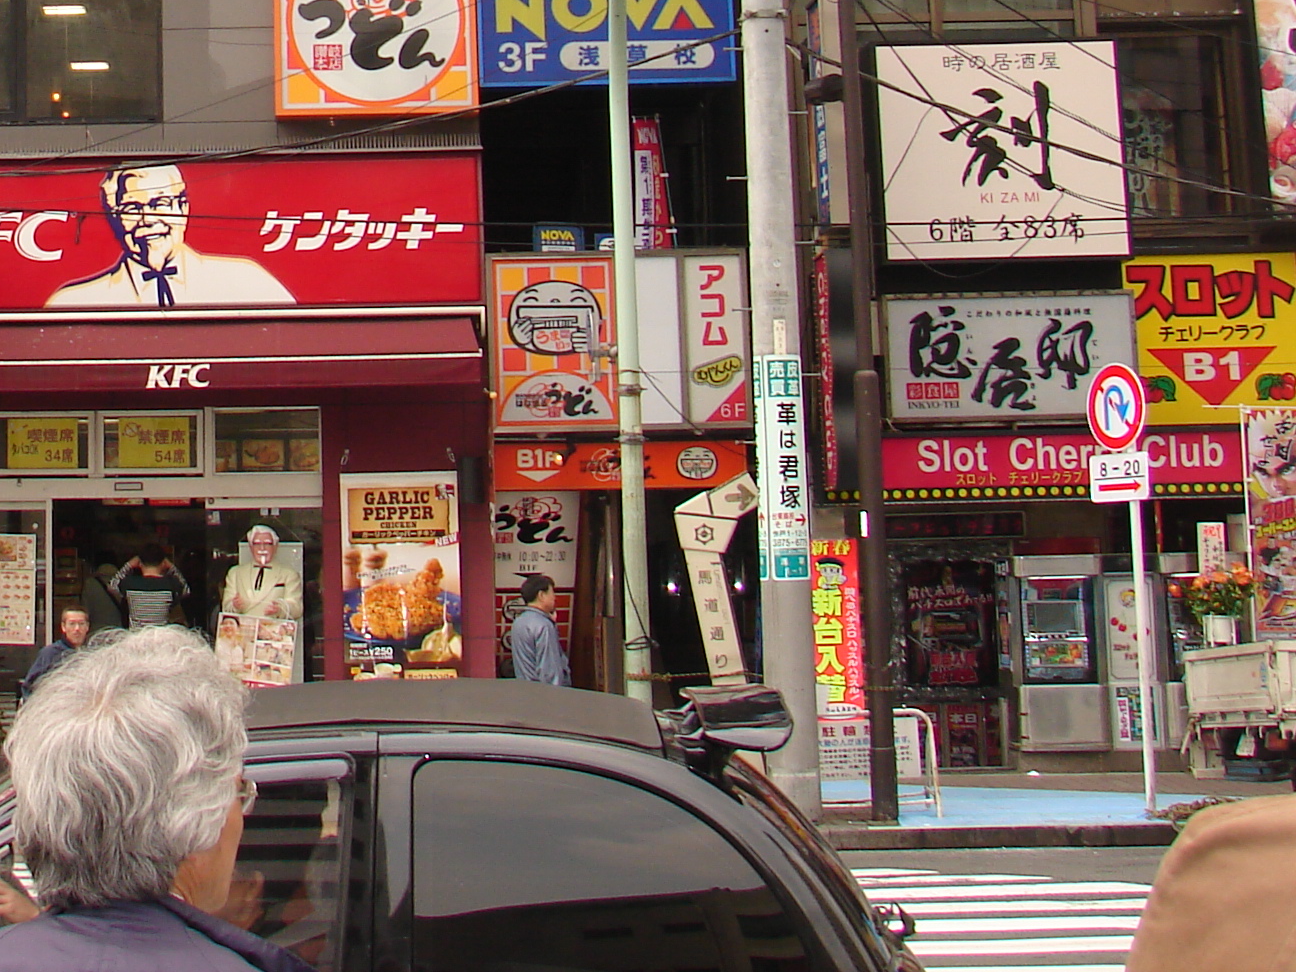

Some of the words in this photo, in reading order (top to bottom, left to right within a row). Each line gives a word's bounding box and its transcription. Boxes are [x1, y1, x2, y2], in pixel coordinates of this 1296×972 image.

[499, 42, 548, 71] 3F
[579, 43, 697, 67] 浅草校
[942, 52, 1061, 71] 時の居酒屋
[260, 207, 465, 252] ケンタッキー
[541, 229, 574, 241] NOVA
[1126, 260, 1295, 321] スロット
[699, 264, 728, 346] アコム
[1159, 324, 1267, 342] チェリークラブ
[1183, 351, 1241, 382] B1
[146, 364, 210, 388] KFC
[544, 382, 599, 417] うどん
[908, 399, 960, 410] INKYO-TEI
[720, 403, 745, 418] 6F
[27, 427, 75, 443] 喫煙席
[139, 429, 186, 444] 禁煙席
[45, 449, 74, 464] 34席
[155, 449, 186, 464] 54席
[776, 402, 801, 509] 革は君塚
[918, 438, 988, 473] Slot
[1009, 437, 1126, 470] Cher
[1142, 435, 1224, 469] Club
[956, 472, 997, 485] スロット
[1008, 471, 1084, 485] チェリークラブ
[364, 491, 430, 505] GARLIC
[362, 506, 434, 520] PEPPER
[380, 521, 417, 529] CHICKEN
[495, 503, 574, 544] うどん
[435, 532, 459, 547] NEW
[698, 568, 729, 670] 馬道通り
